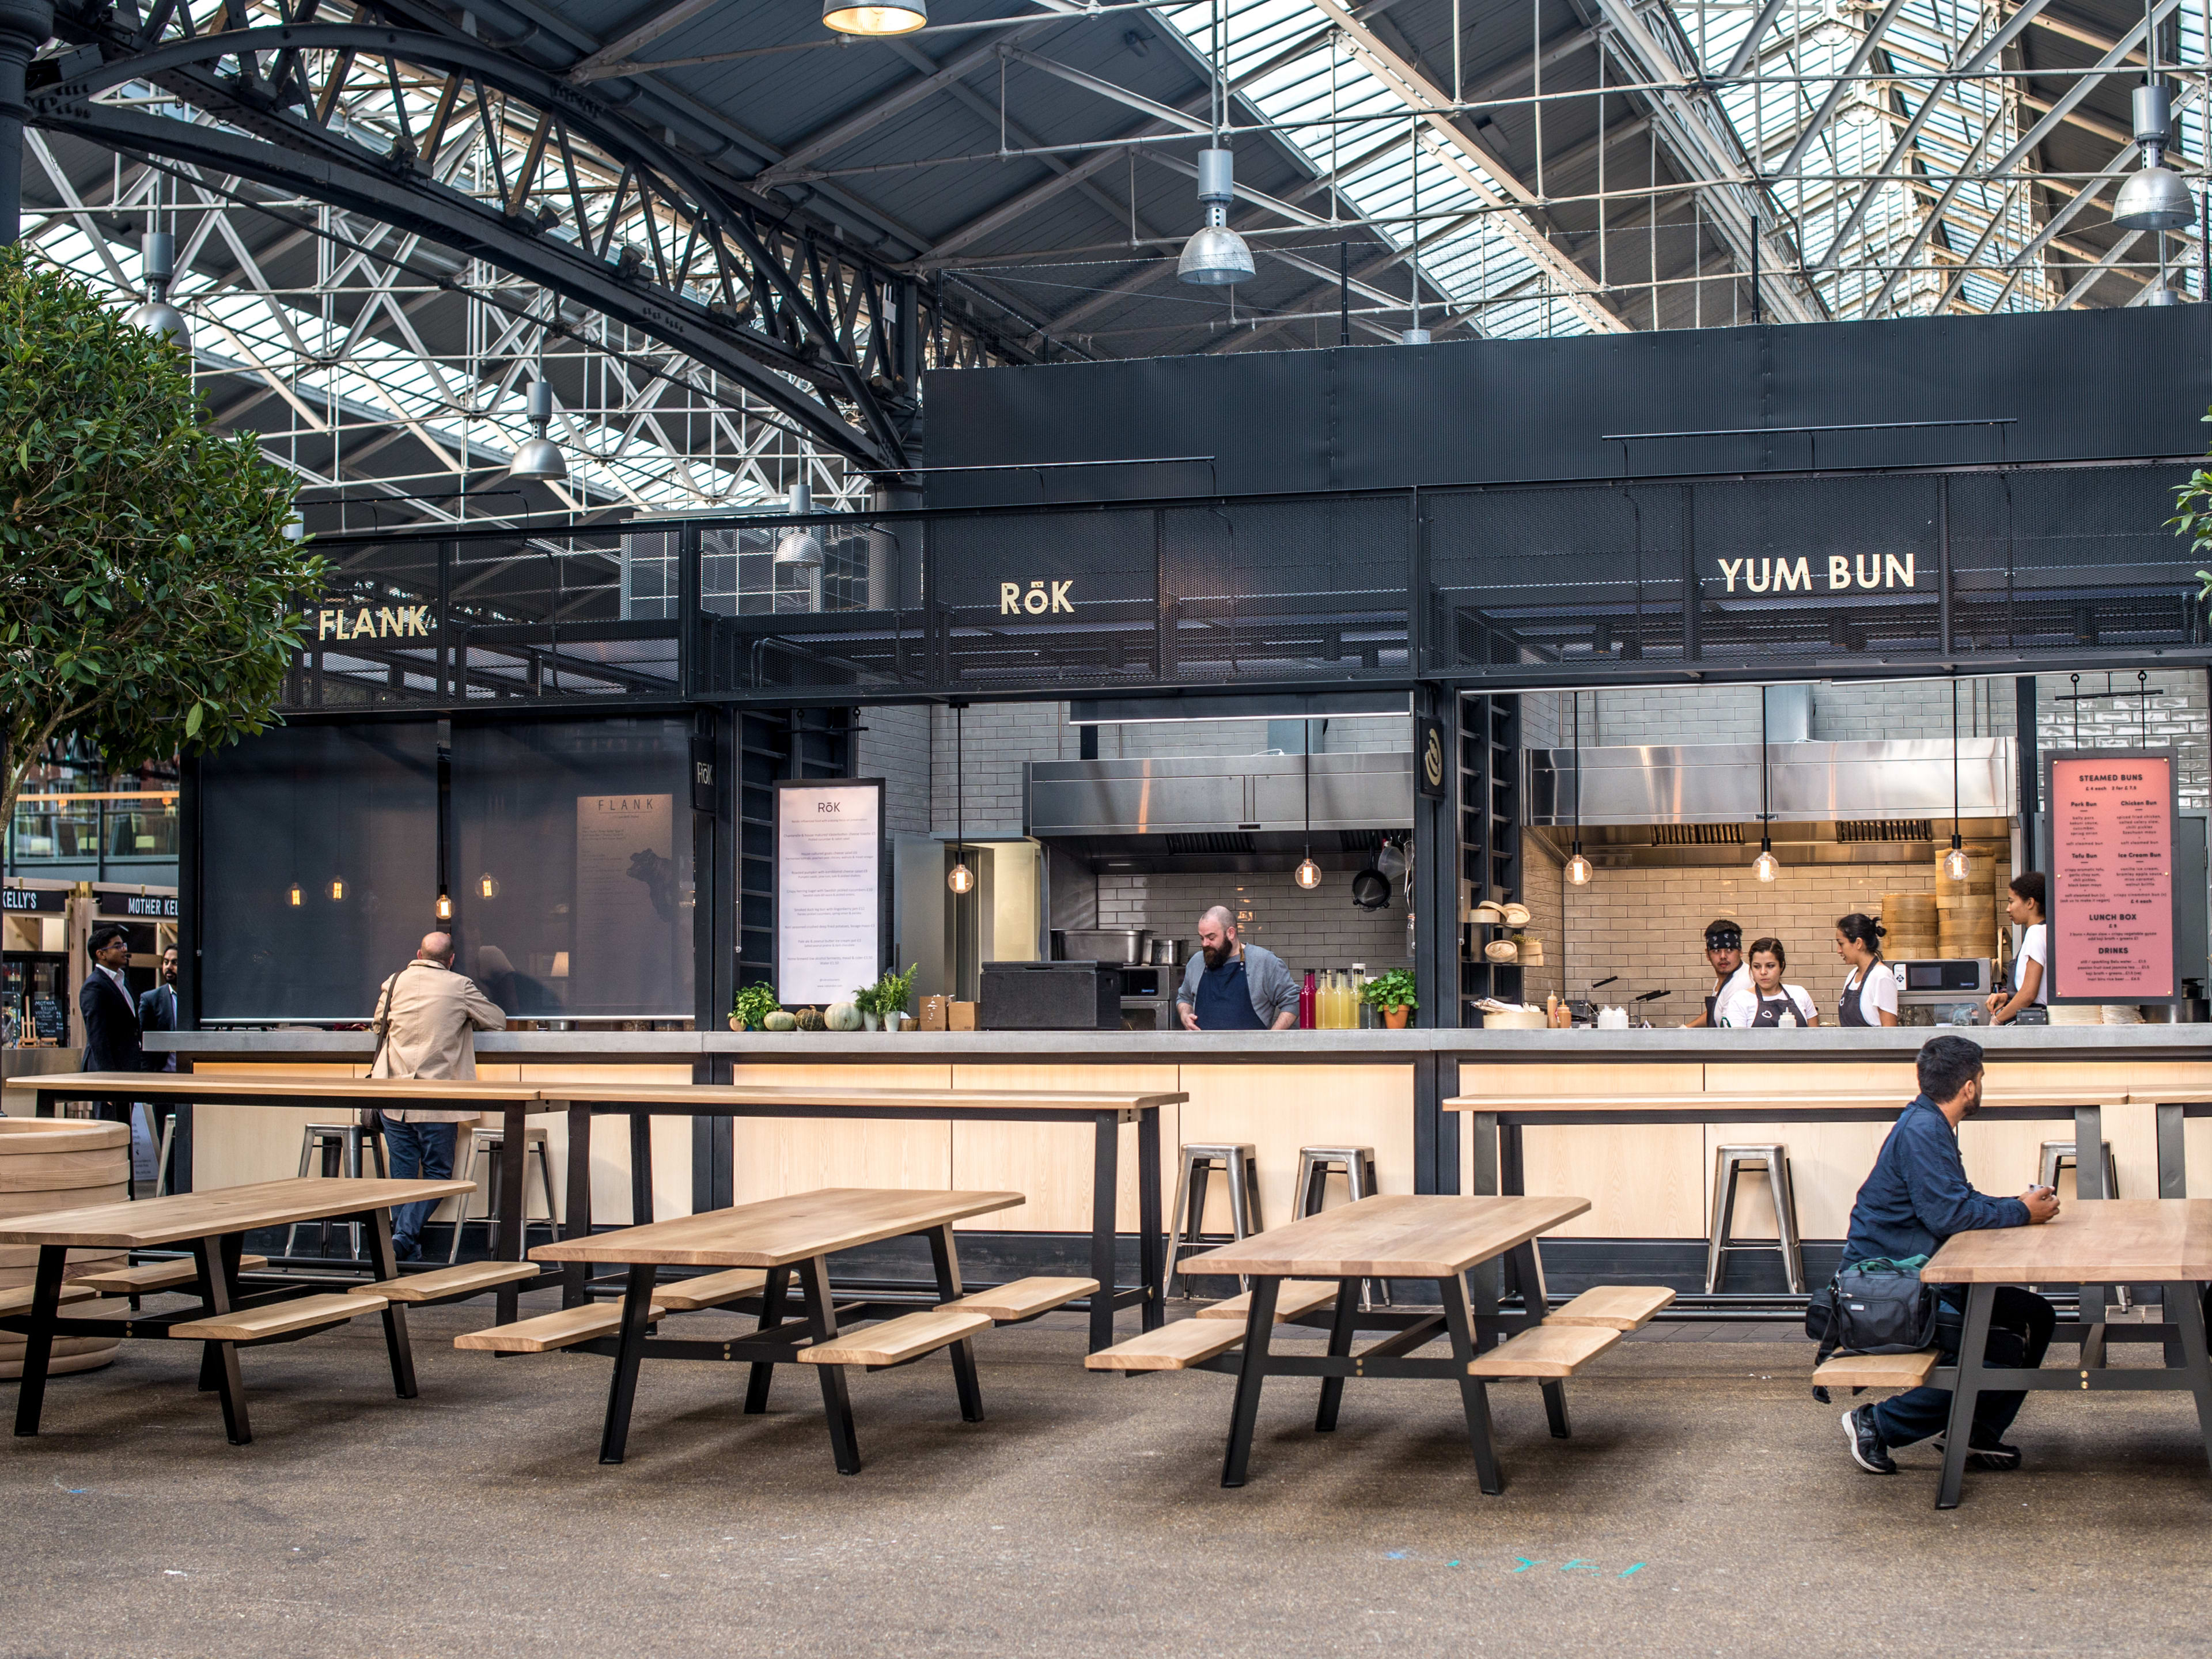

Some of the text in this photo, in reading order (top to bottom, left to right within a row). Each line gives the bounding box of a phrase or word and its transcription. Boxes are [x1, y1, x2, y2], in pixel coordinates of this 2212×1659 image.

[1718, 553, 1914, 593] YUM BUN
[1001, 580, 1075, 615] RōK
[319, 605, 429, 641] FLANK
[697, 762, 713, 786] RōK
[599, 798, 653, 810] FLANK
[818, 802, 840, 813] RōK
[128, 897, 161, 915] MOTHER
